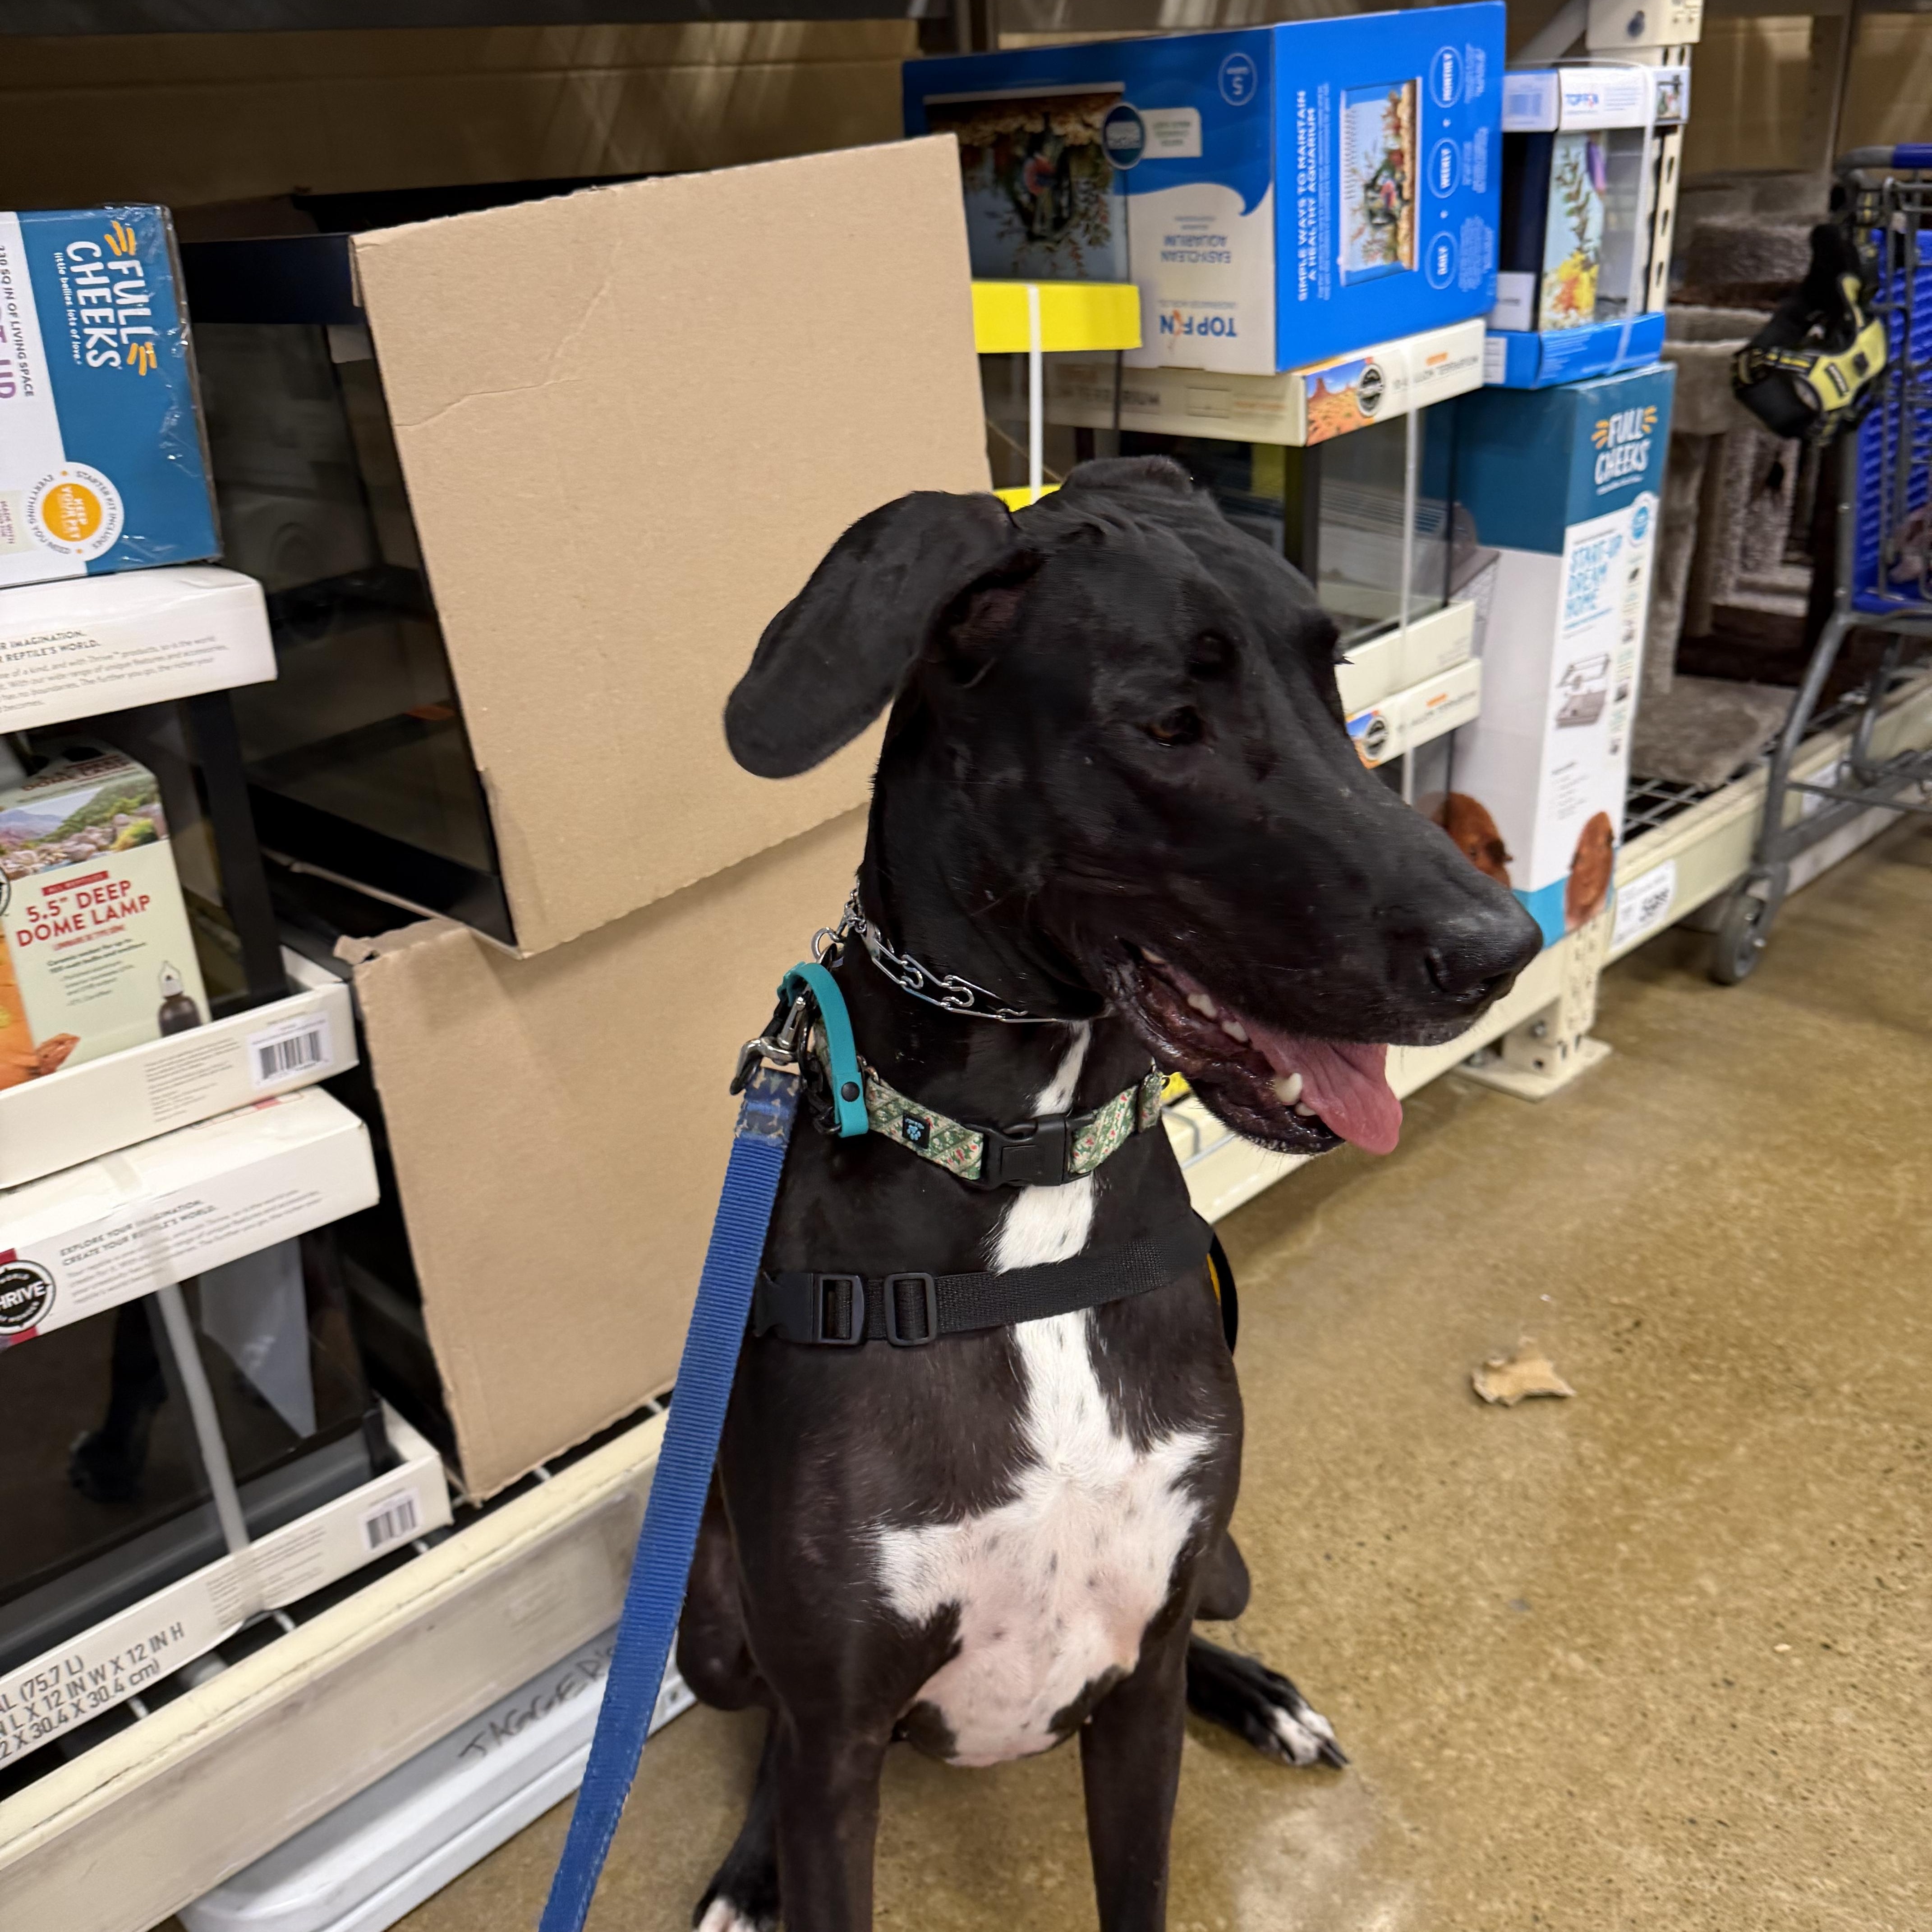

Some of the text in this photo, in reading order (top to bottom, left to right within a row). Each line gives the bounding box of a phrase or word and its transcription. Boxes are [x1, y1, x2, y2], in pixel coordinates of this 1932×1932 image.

[1296, 90, 1308, 301] SIMPLE WAYS TO MAINTAIN
[1307, 107, 1317, 281] A HEALTHY AQUARIUM
[54, 252, 66, 275] little
[4, 287, 14, 299] IN
[7, 303, 19, 317] OF
[66, 241, 121, 368] CHEEKS
[107, 259, 154, 345] FULL
[67, 309, 77, 327] lots
[70, 329, 81, 340] of
[11, 321, 27, 360] LIVING
[19, 362, 35, 396] SPACE
[1607, 407, 1644, 448] FULL
[1595, 438, 1651, 485] CHEEKS
[75, 880, 132, 909] DEEP
[16, 894, 151, 948] DOME LAMP
[0, 1280, 46, 1310] HRIVE
[9, 1712, 24, 1730] L
[24, 1702, 40, 1722] X
[42, 1689, 64, 1711] 12
[65, 1678, 87, 1700] IN
[89, 1664, 107, 1687] W
[109, 1656, 125, 1676] X
[126, 1643, 148, 1665] 12
[148, 1630, 170, 1652] IN
[170, 1621, 185, 1642] H
[20, 1665, 61, 1702] (75.7
[65, 1654, 84, 1677] L)
[13, 1732, 30, 1751] X
[32, 1711, 69, 1740] 30.4
[70, 1699, 86, 1718] X
[89, 1679, 126, 1709] 30.4
[129, 1658, 161, 1687] cm)
